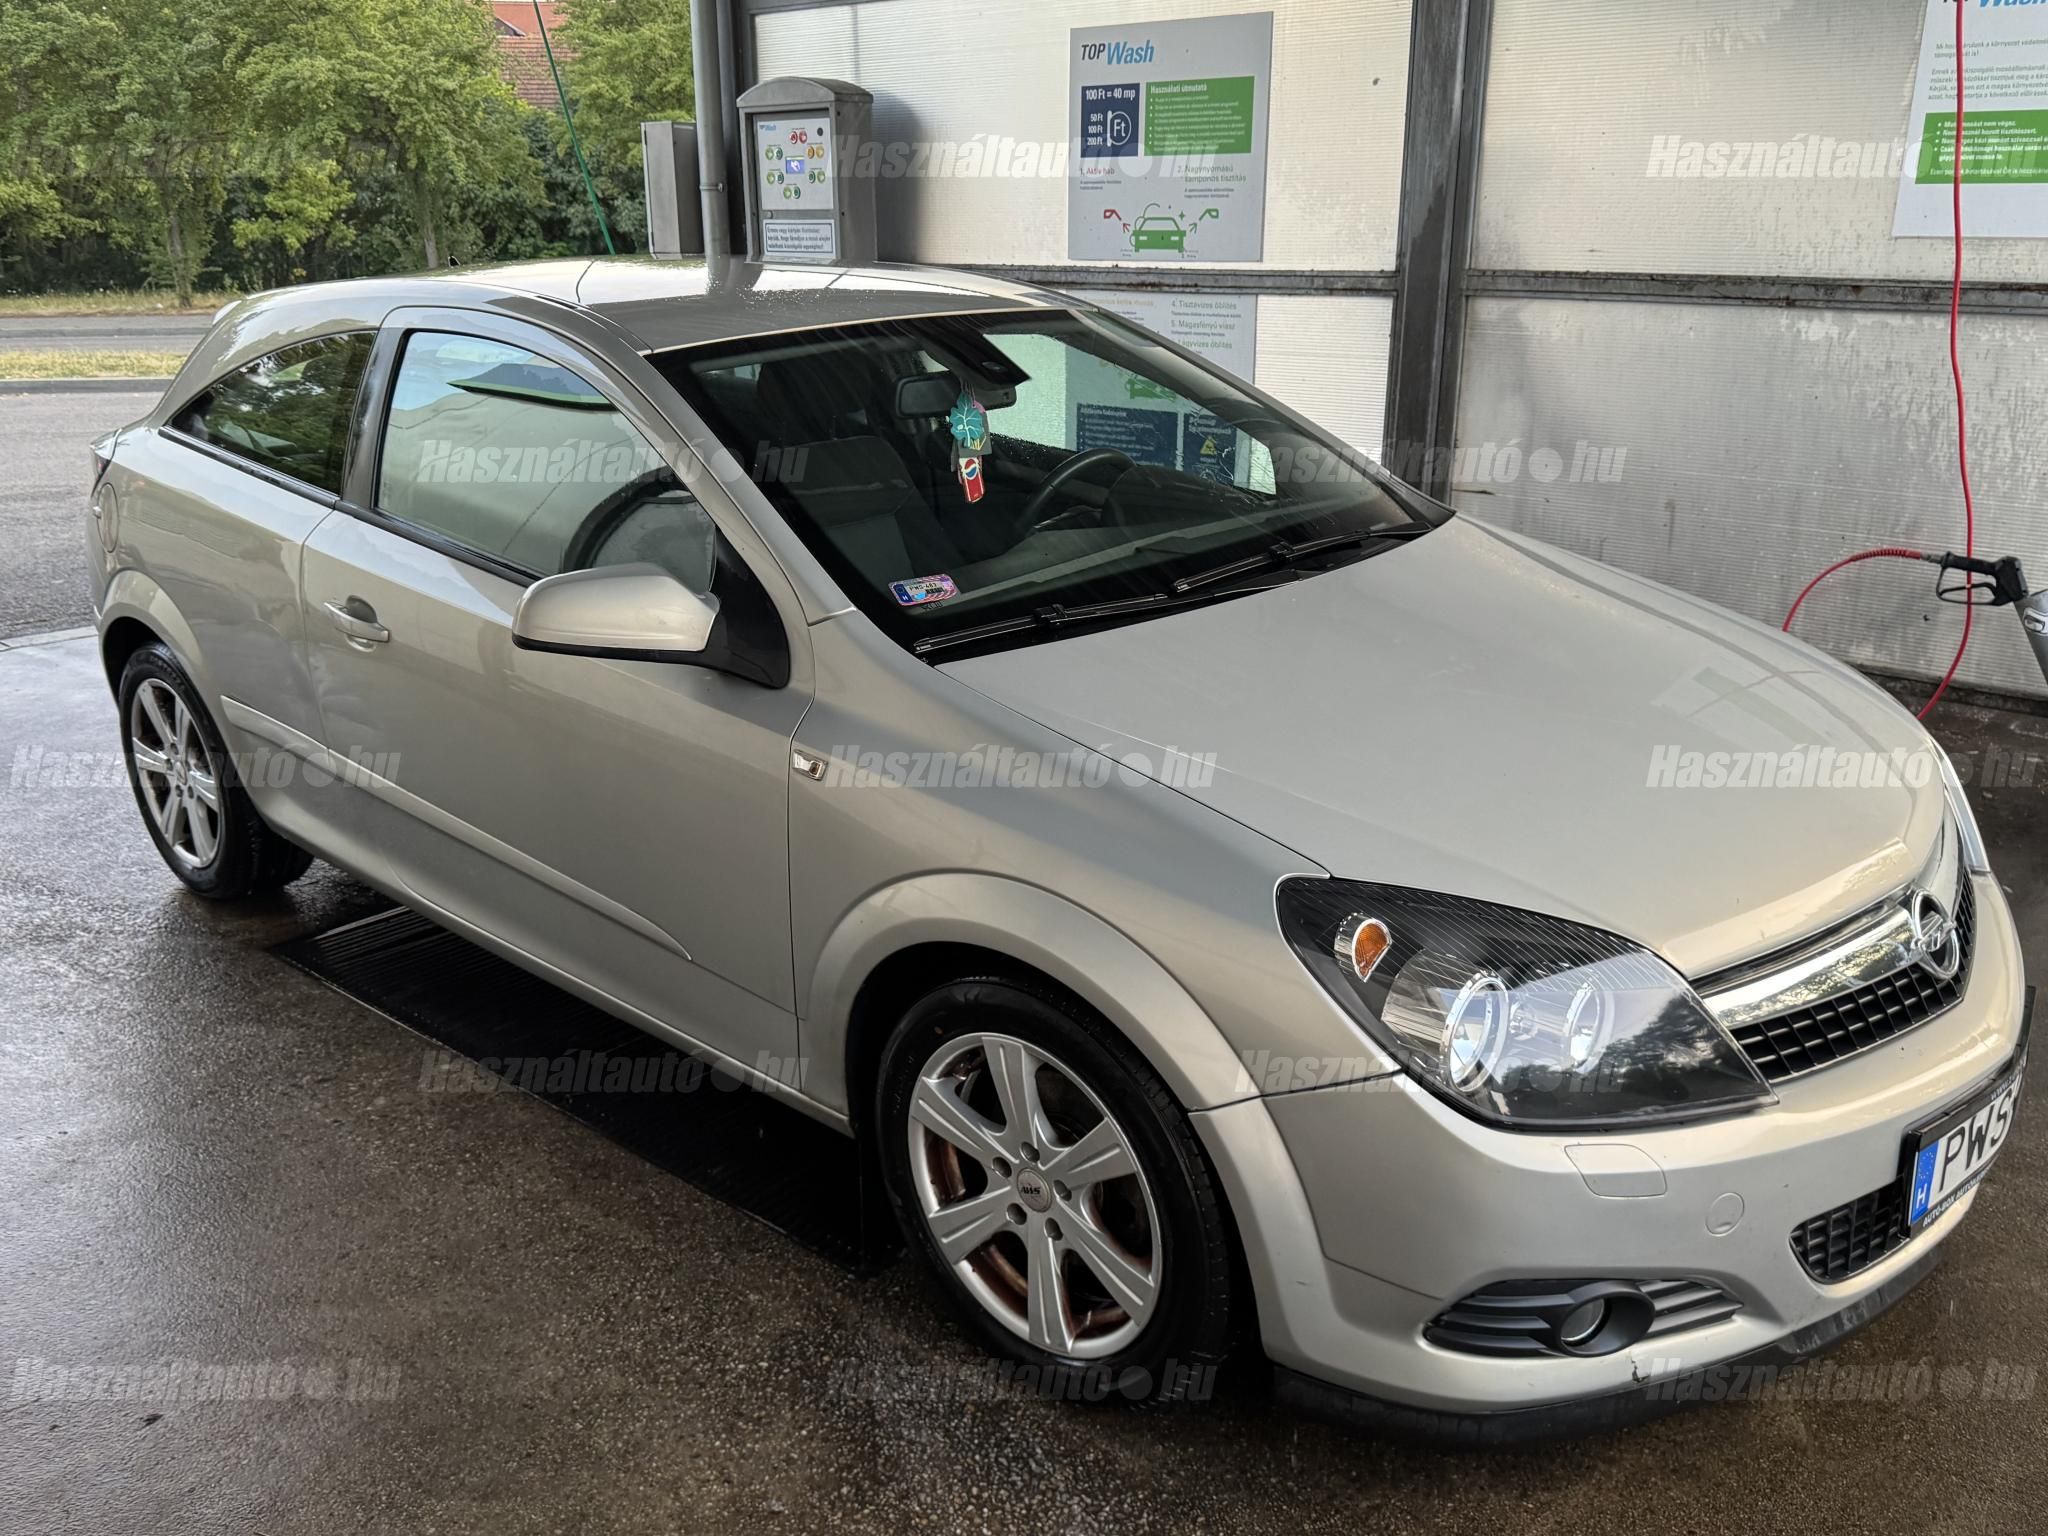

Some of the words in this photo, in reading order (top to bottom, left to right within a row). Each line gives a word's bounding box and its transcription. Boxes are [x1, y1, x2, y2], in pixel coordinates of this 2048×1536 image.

[1086, 89, 1097, 101] 100
[1098, 88, 1106, 100] Ft
[1113, 88, 1122, 99] 40
[1123, 89, 1136, 101] mp
[1113, 119, 1126, 137] Ft
